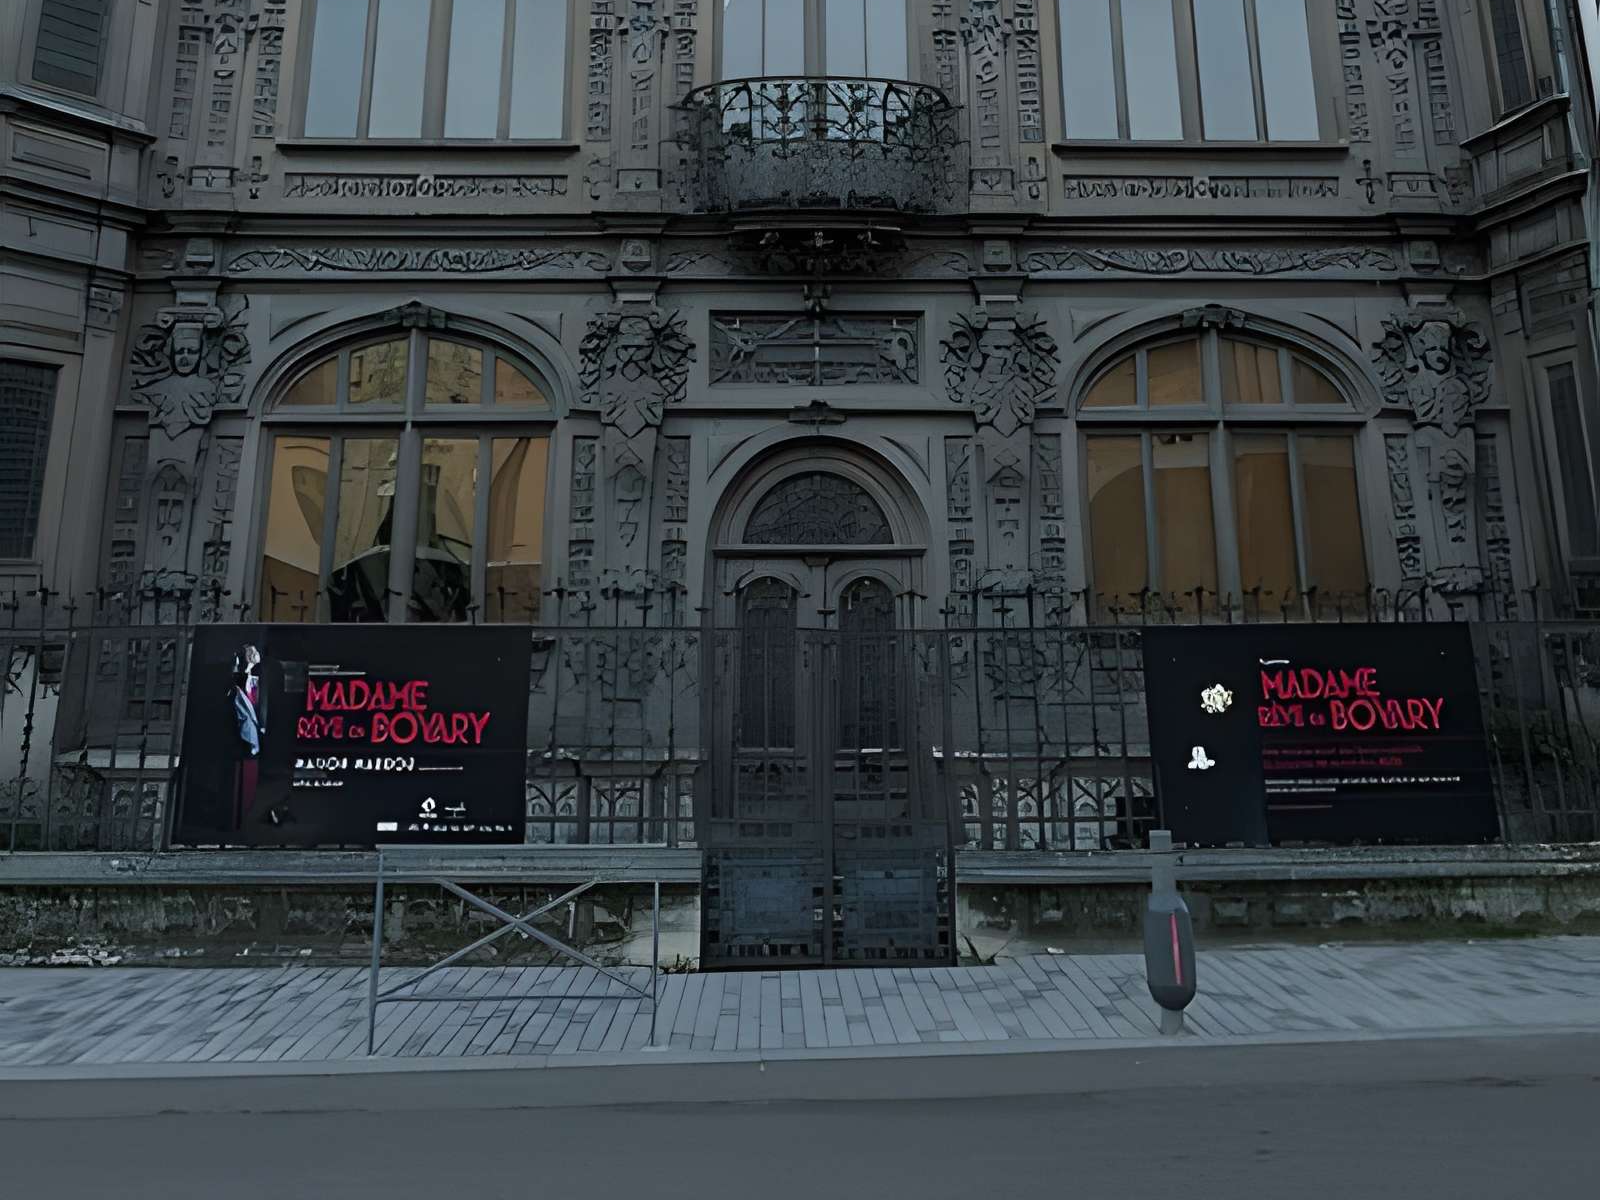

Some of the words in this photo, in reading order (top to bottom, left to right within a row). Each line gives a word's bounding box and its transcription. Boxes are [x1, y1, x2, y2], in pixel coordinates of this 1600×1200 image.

[306, 679, 429, 711] MADAME
[1260, 667, 1380, 699] MADAME
[371, 711, 491, 744] BOVARY
